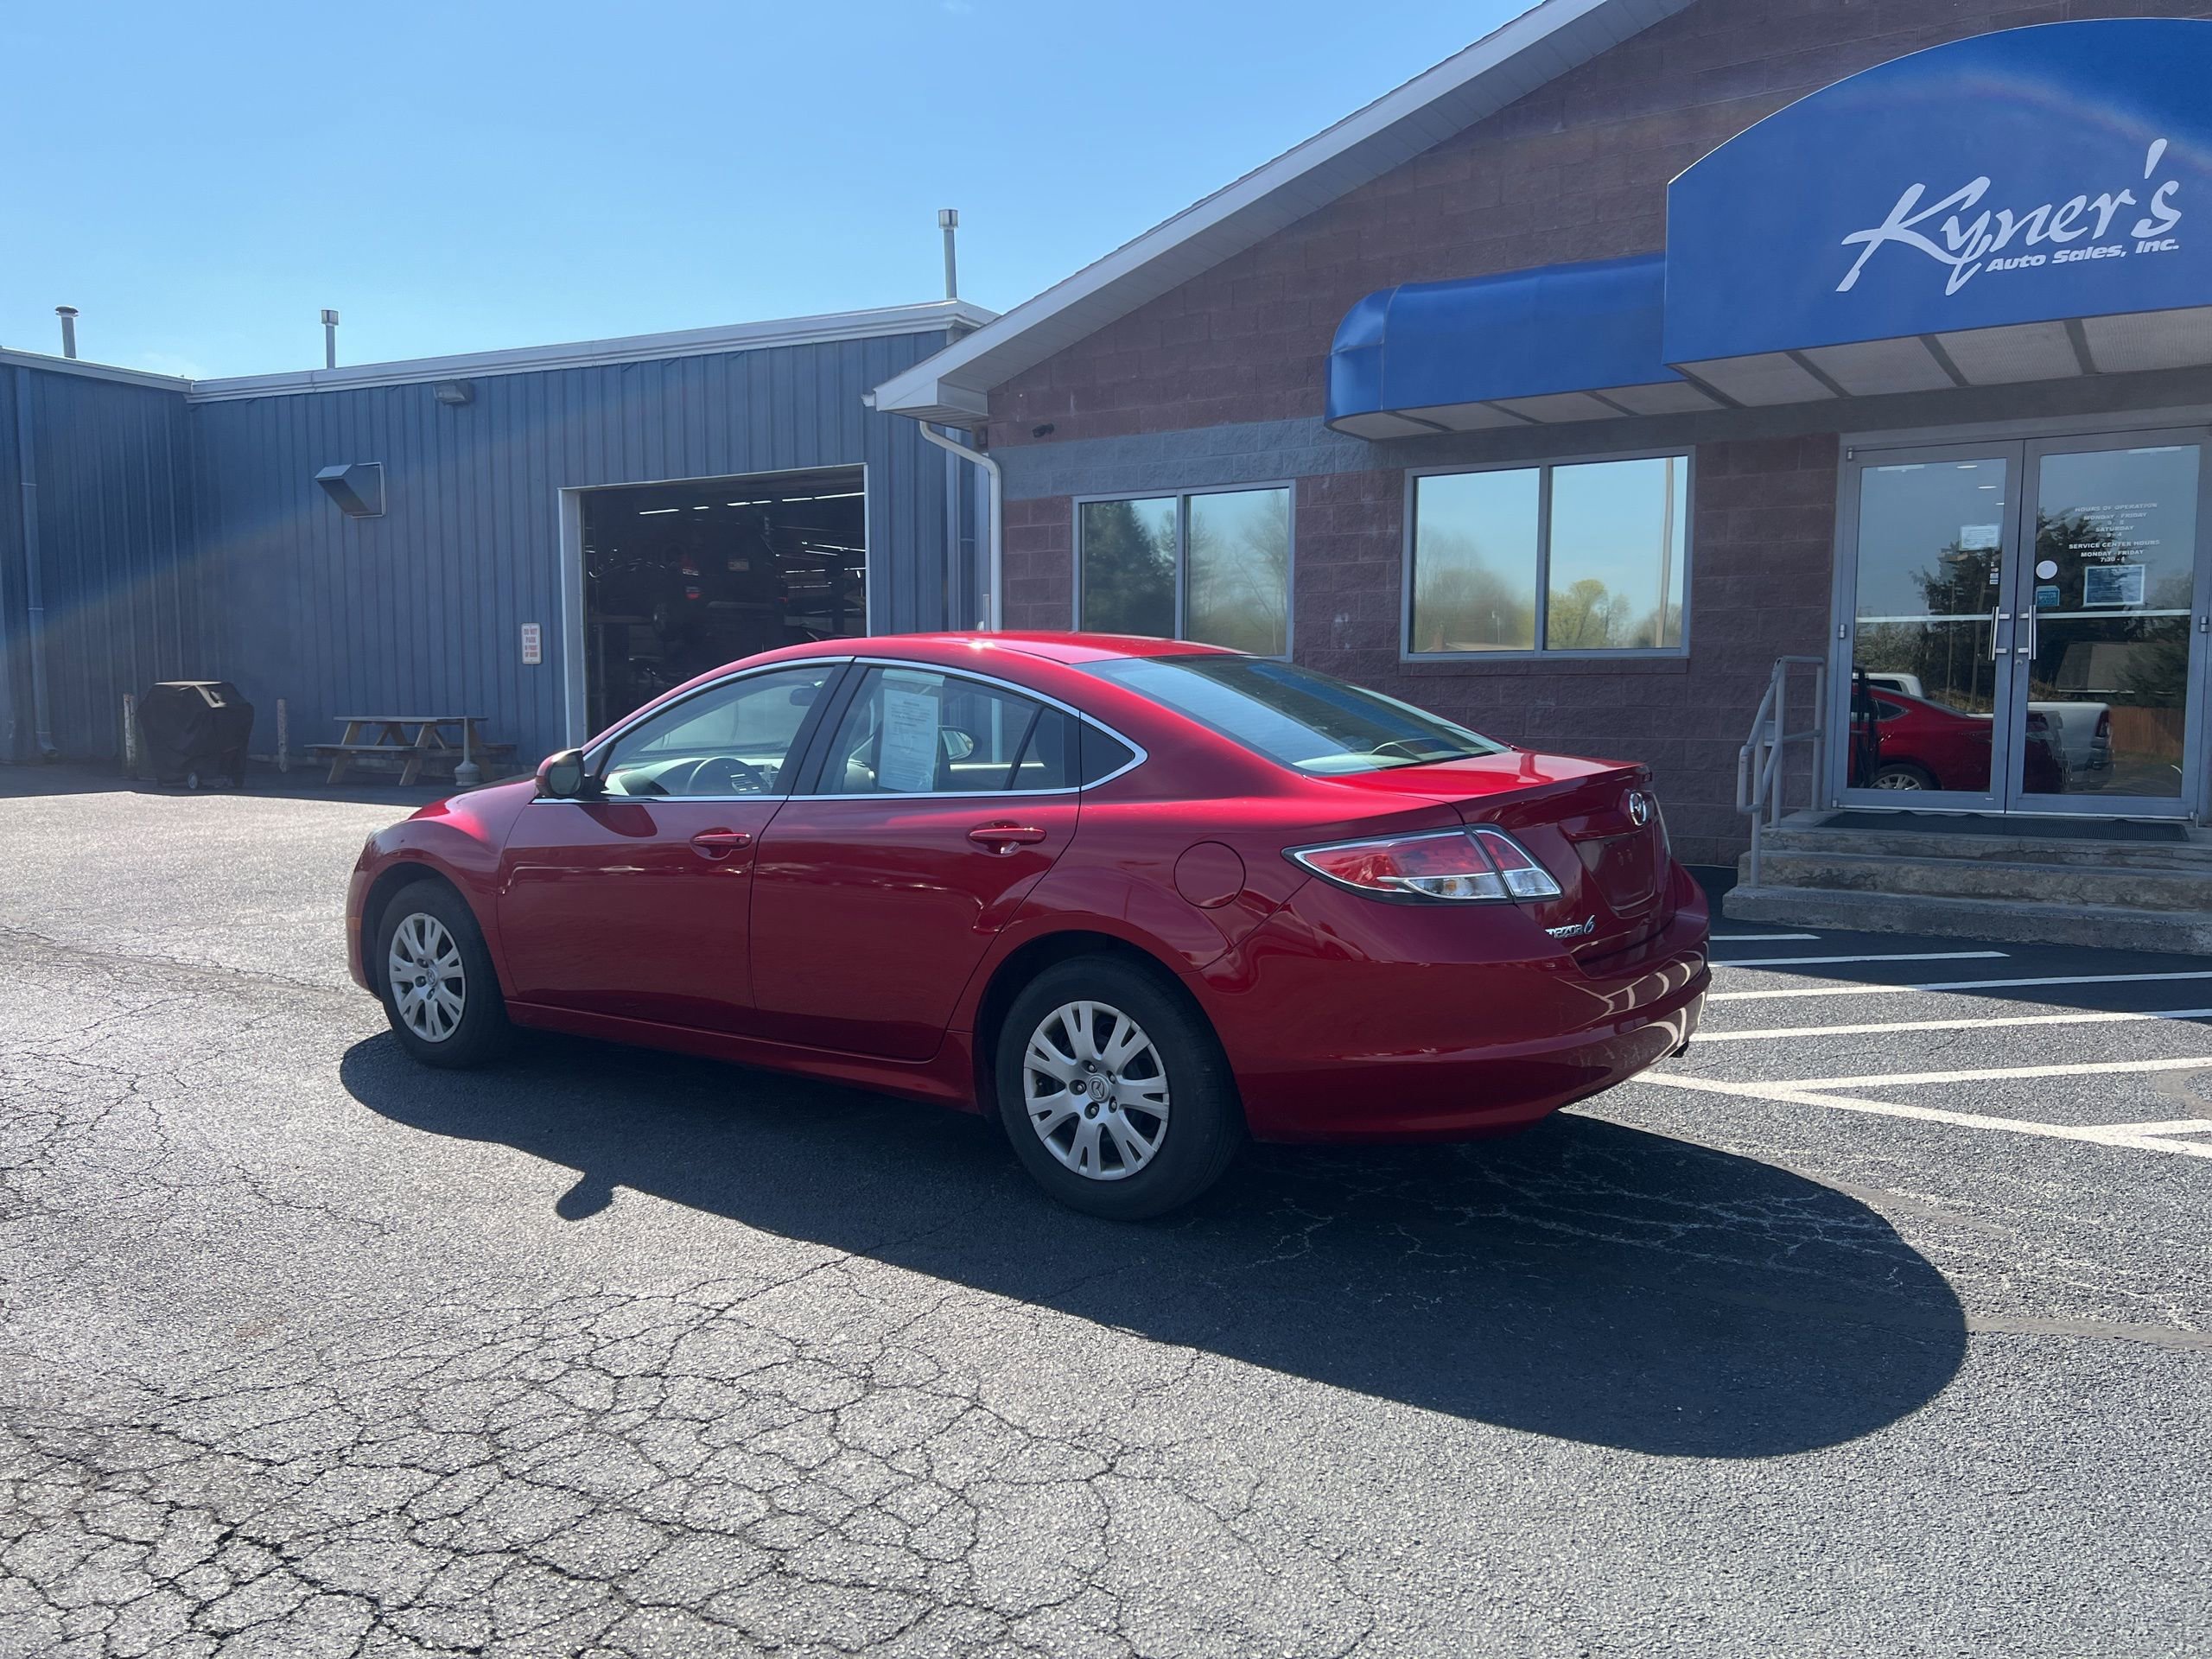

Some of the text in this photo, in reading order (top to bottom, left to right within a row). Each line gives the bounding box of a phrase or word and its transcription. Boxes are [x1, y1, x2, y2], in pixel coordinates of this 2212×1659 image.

[1835, 138, 2182, 296] Kyner's
[1985, 238, 2180, 272] Auto Sales, Inc.
